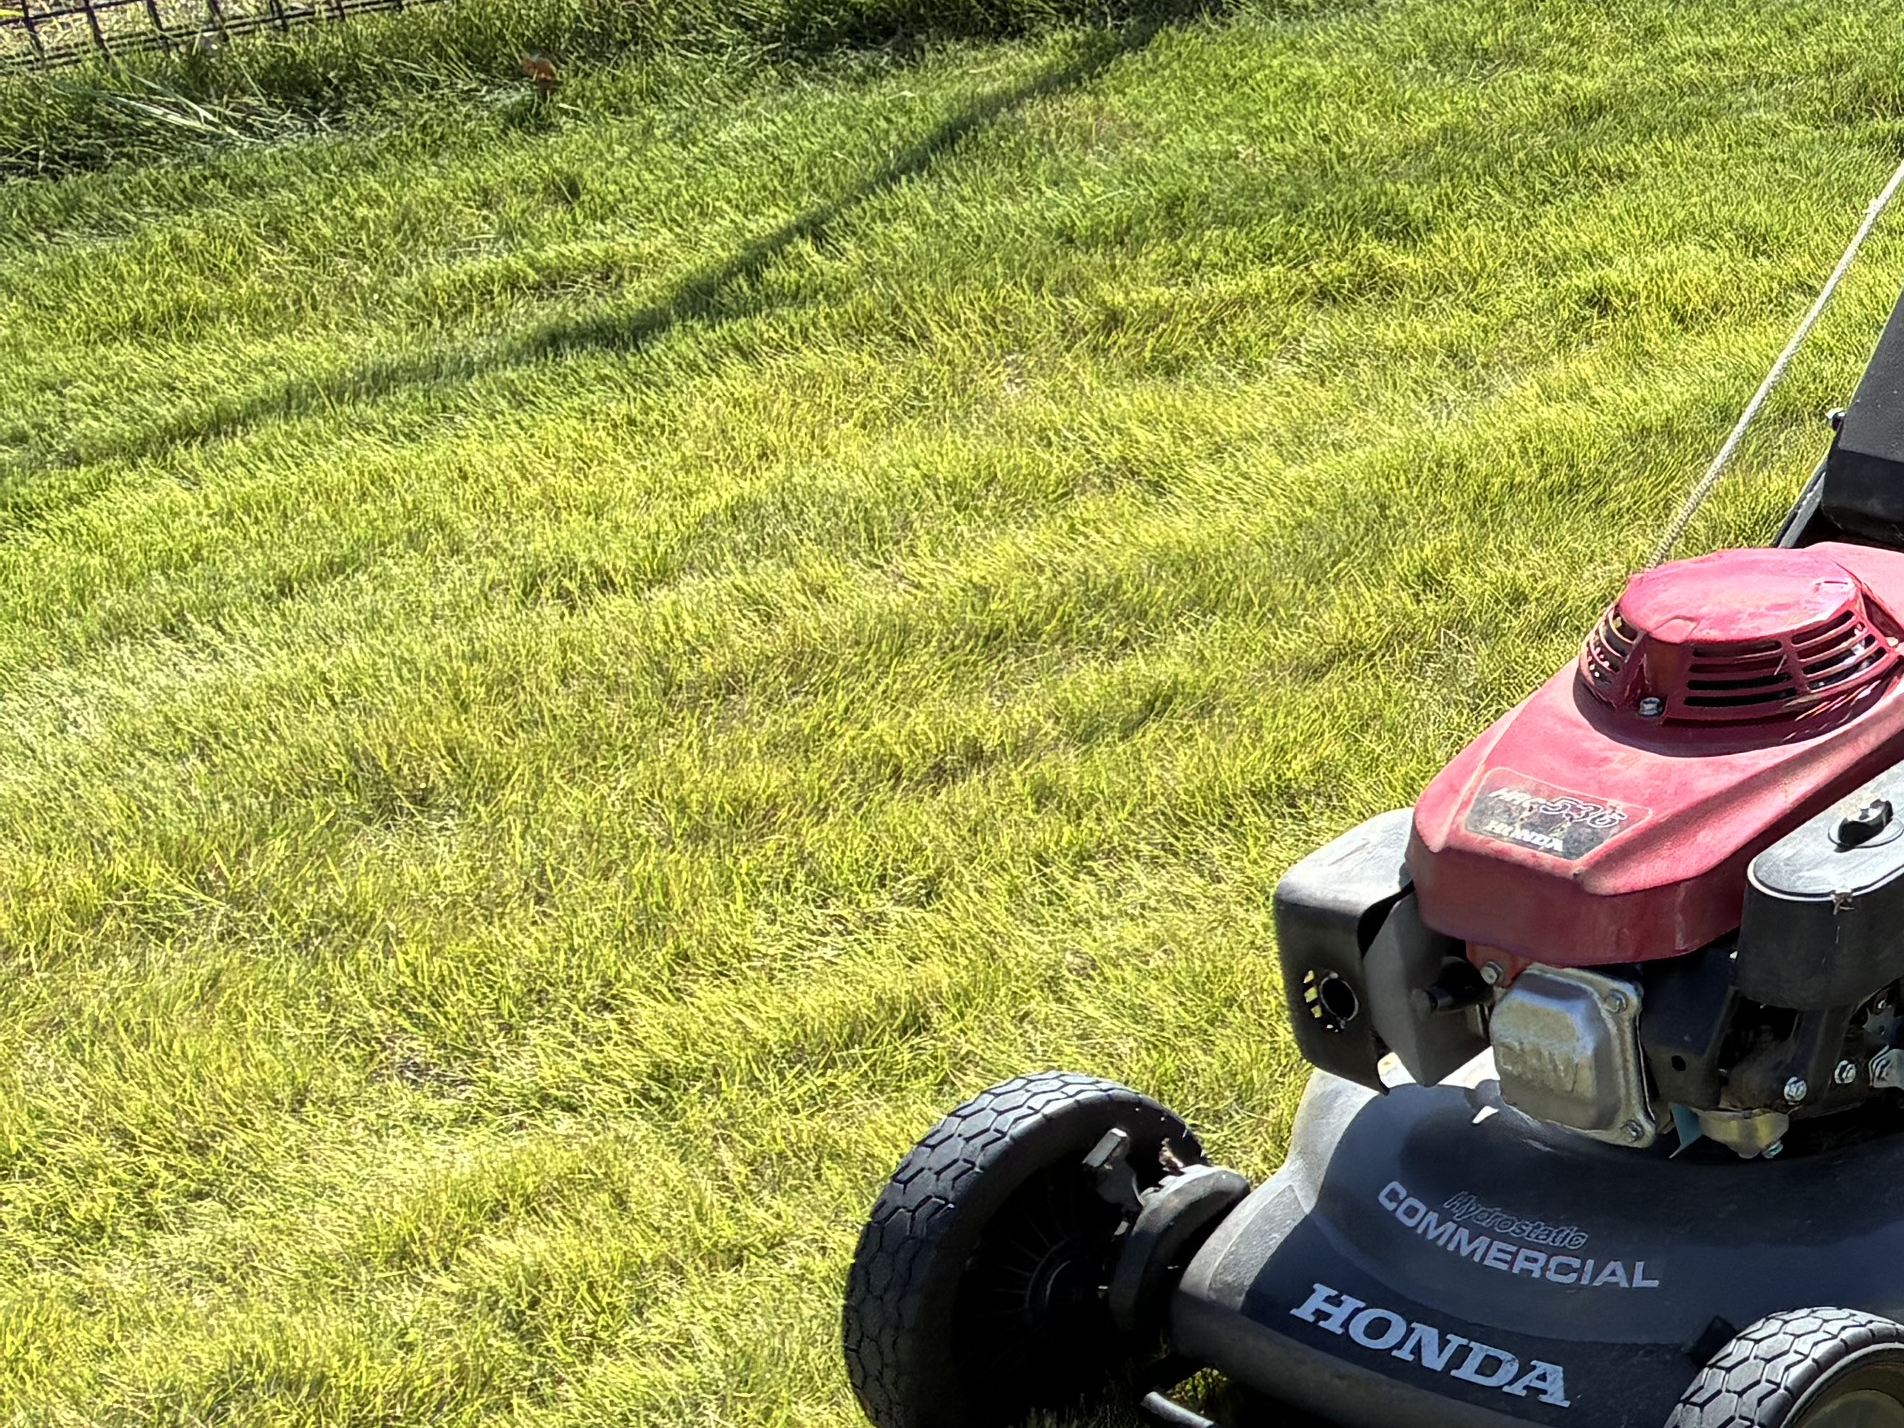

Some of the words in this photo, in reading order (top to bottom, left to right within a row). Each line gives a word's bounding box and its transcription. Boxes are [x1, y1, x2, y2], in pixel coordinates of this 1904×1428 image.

[1377, 1180, 1660, 1289] COMMERCIAL
[1443, 1190, 1589, 1250] Hydrostatic
[1289, 1282, 1571, 1409] HONDA
